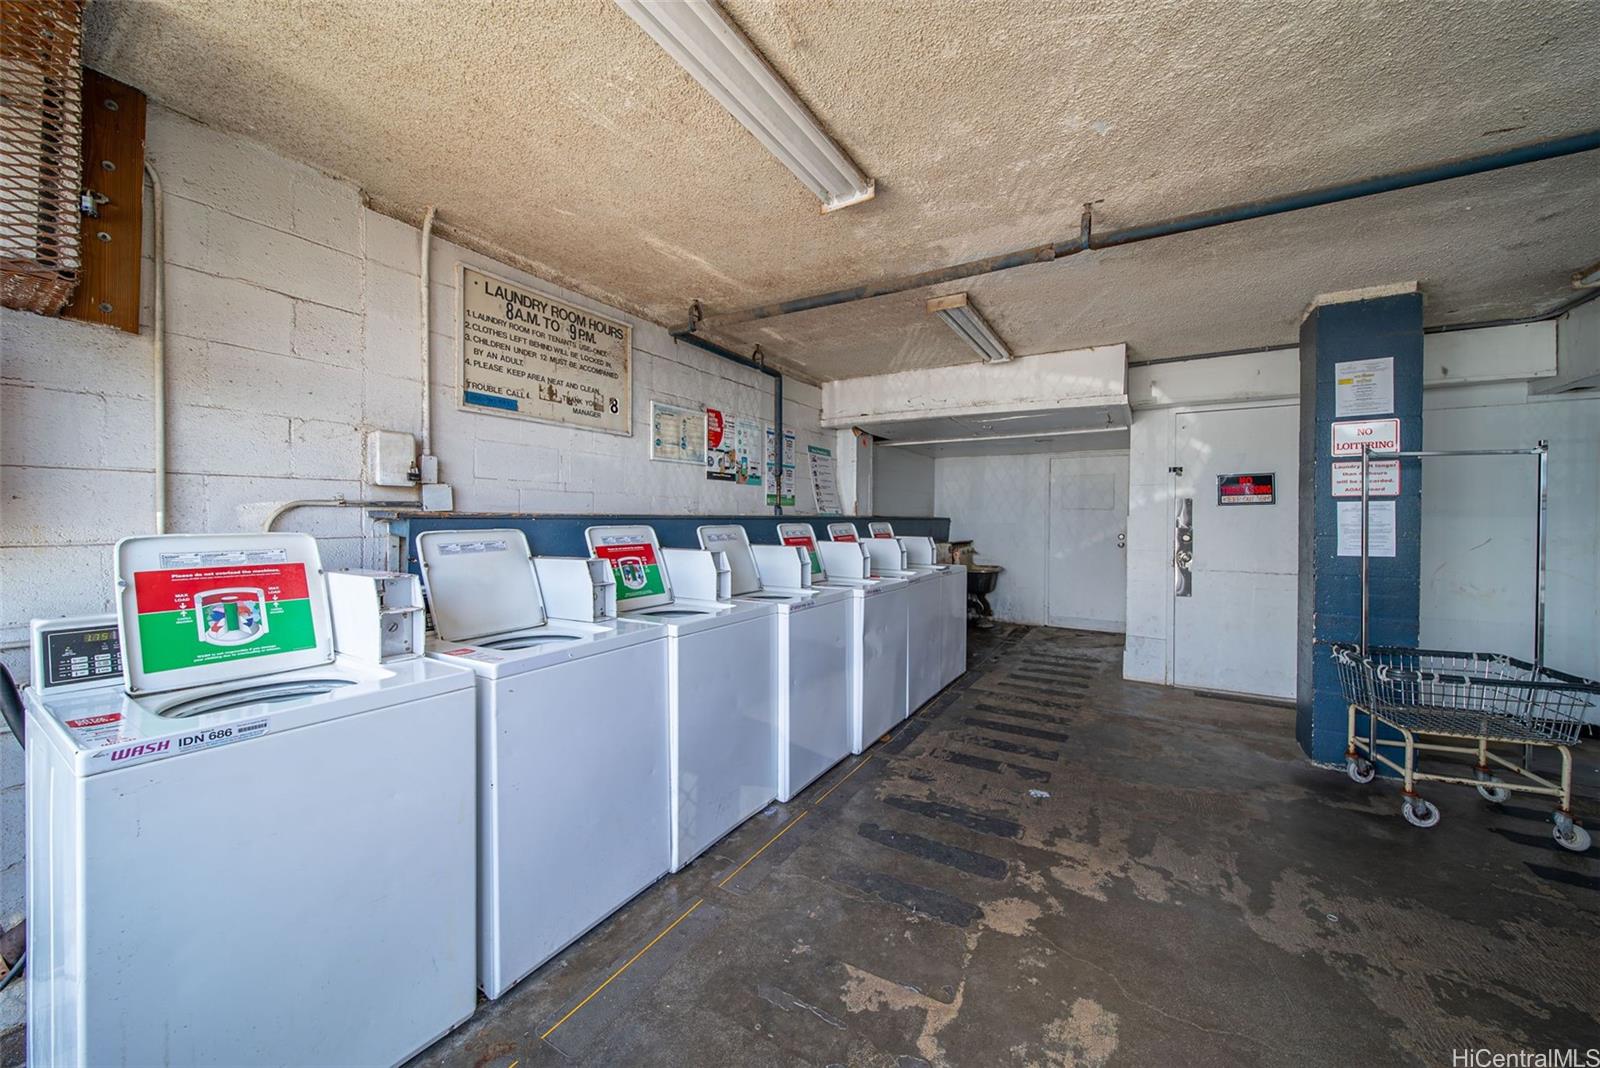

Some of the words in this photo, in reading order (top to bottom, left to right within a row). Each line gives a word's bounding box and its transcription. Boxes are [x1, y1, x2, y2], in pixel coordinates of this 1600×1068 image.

[485, 282, 548, 314] LAUNDRY
[551, 306, 586, 327] ROOM
[589, 318, 623, 340] HOURS
[473, 311, 507, 327] LAUNDRY
[509, 322, 530, 334] ROOM
[532, 330, 545, 339] FOR
[542, 316, 560, 332] TO
[472, 323, 507, 339] CLOTHES
[510, 334, 527, 344] LEFT
[529, 339, 552, 351] BEHIND
[554, 346, 568, 356] WILL
[570, 351, 578, 359] BE
[580, 354, 604, 366] LOCKED
[474, 348, 483, 356] BY
[473, 335, 510, 351] CHILDREN
[514, 347, 537, 358] UNDER
[550, 356, 567, 366] MUST
[579, 364, 619, 379] ACCOMPANIED
[474, 360, 504, 373] PLEASE
[506, 368, 526, 377] KEEP
[527, 373, 545, 382] AREA
[547, 377, 563, 386] NEAT
[566, 382, 578, 390] AND
[466, 381, 503, 394] TROUBLE
[506, 389, 525, 399] CALL
[573, 408, 601, 418] MANAGER
[178, 734, 204, 747] IDN
[208, 728, 232, 740] 686
[111, 740, 170, 761] WASH
